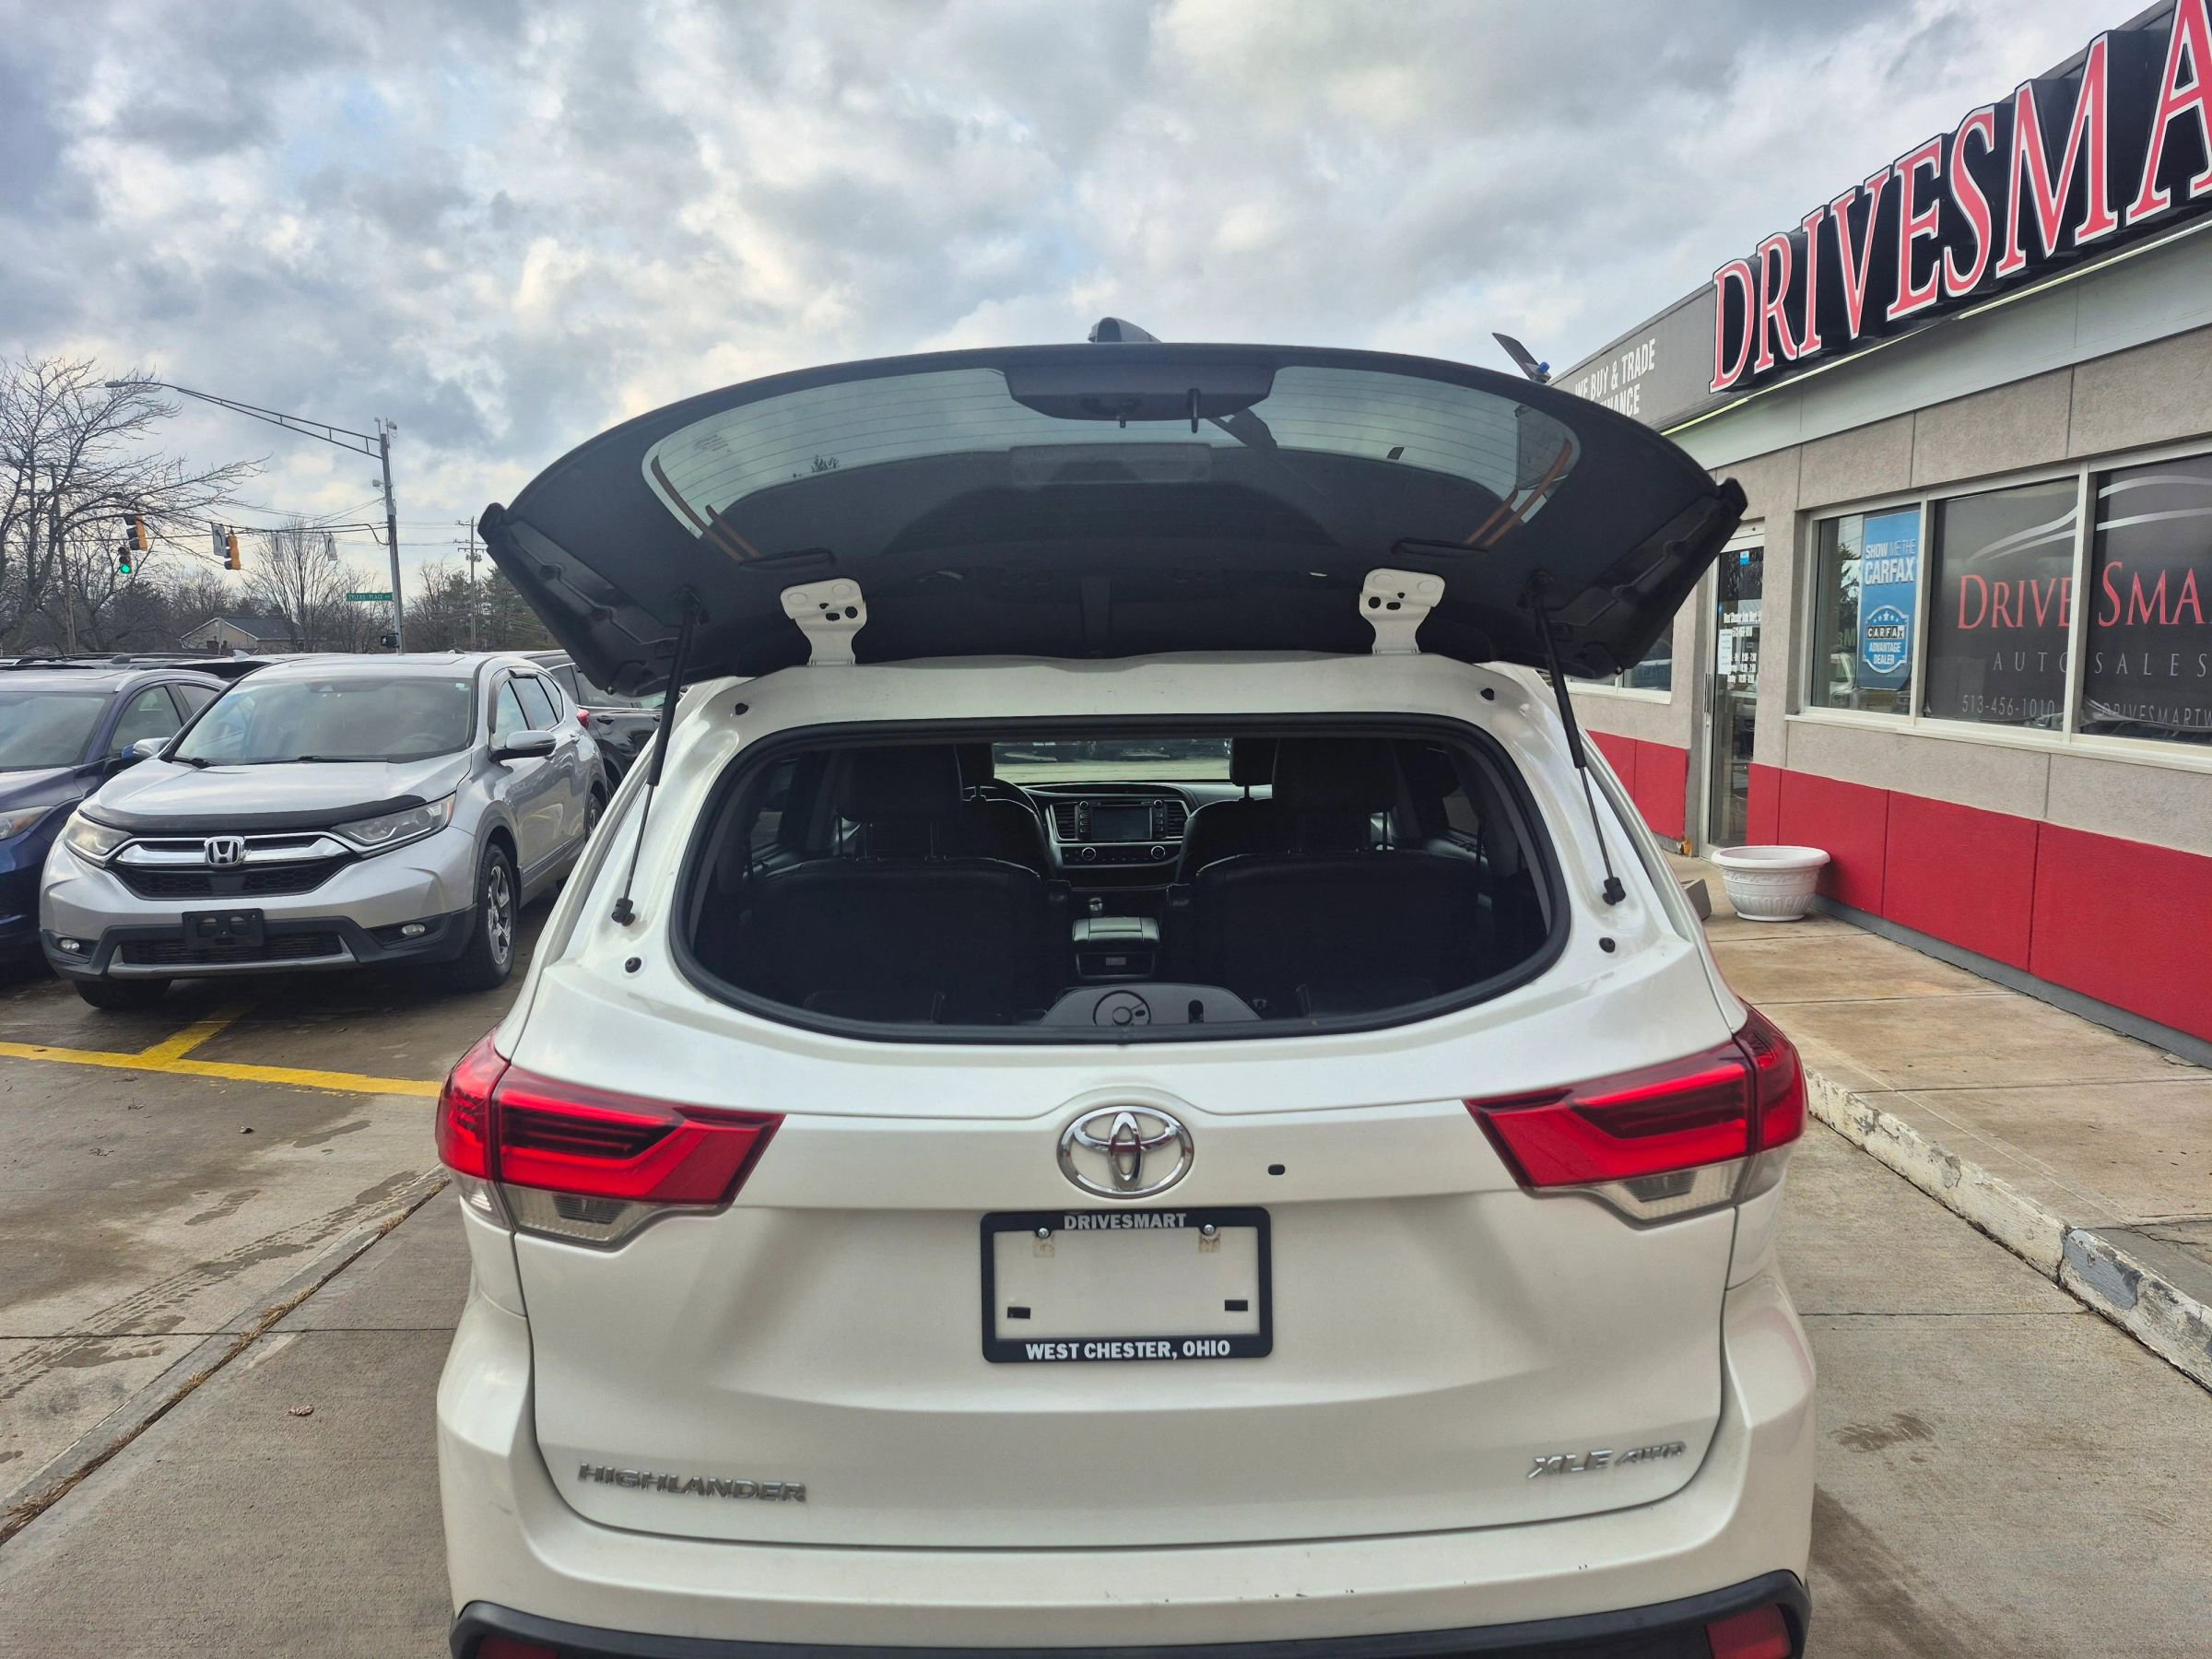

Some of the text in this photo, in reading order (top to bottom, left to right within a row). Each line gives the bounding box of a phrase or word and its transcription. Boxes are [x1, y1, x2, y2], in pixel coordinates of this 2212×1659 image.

[1710, 0, 2212, 394] DRIVESMA
[1591, 366, 1608, 401] BUY
[1611, 360, 1618, 390] &
[1621, 338, 1655, 384] TRADE
[1599, 383, 1640, 418] ANCE
[1865, 543, 1888, 559] SHOW
[1865, 557, 1915, 585] CARFAX
[1867, 626, 1904, 639] CARFAX
[1868, 641, 1901, 653] ADVANTAGE
[1873, 653, 1895, 665] DEALER
[2094, 652, 2207, 677] SALES
[1961, 694, 2055, 718] 513-456-1010
[1064, 1214, 1187, 1230] DRIVESMART
[1025, 1340, 1230, 1360] WEST CHESTER, OHIO
[1526, 1441, 1687, 1478] XLE AWD
[577, 1462, 807, 1503] HIGHLANDER
